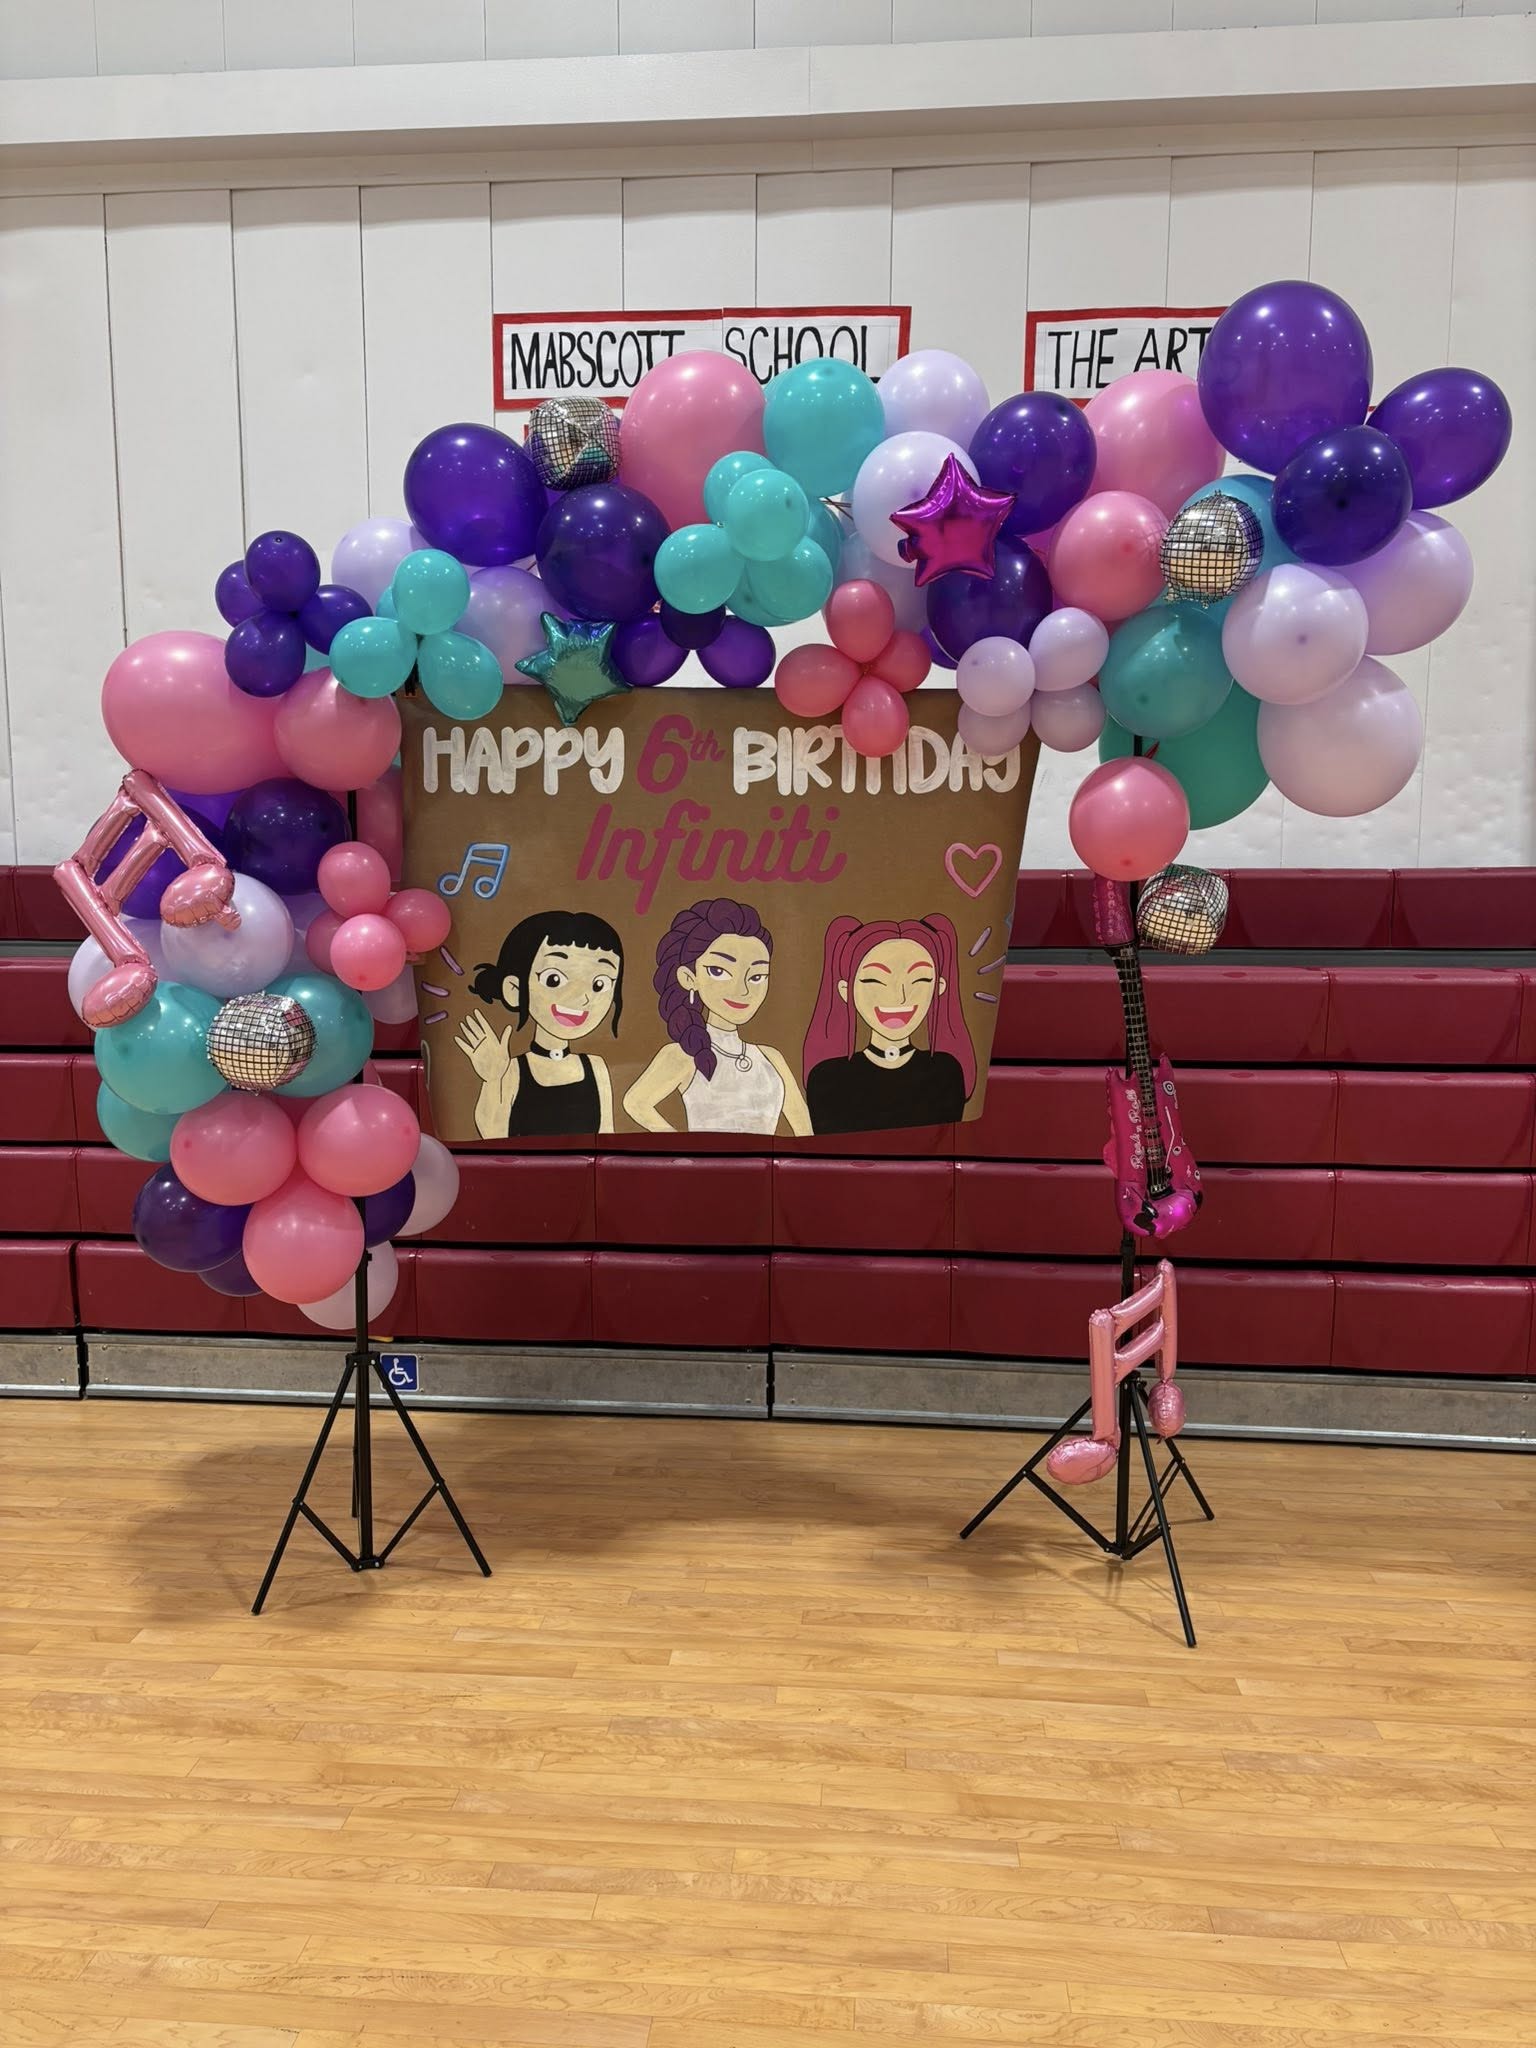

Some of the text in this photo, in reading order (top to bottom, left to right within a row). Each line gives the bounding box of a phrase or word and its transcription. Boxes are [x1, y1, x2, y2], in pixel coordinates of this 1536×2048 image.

[511, 325, 881, 390] MABSCOTT SCHOOL
[1047, 328, 1118, 389] THE
[423, 726, 625, 796] HAPPY
[636, 713, 726, 794] 6th
[576, 798, 848, 916] Infiniti
